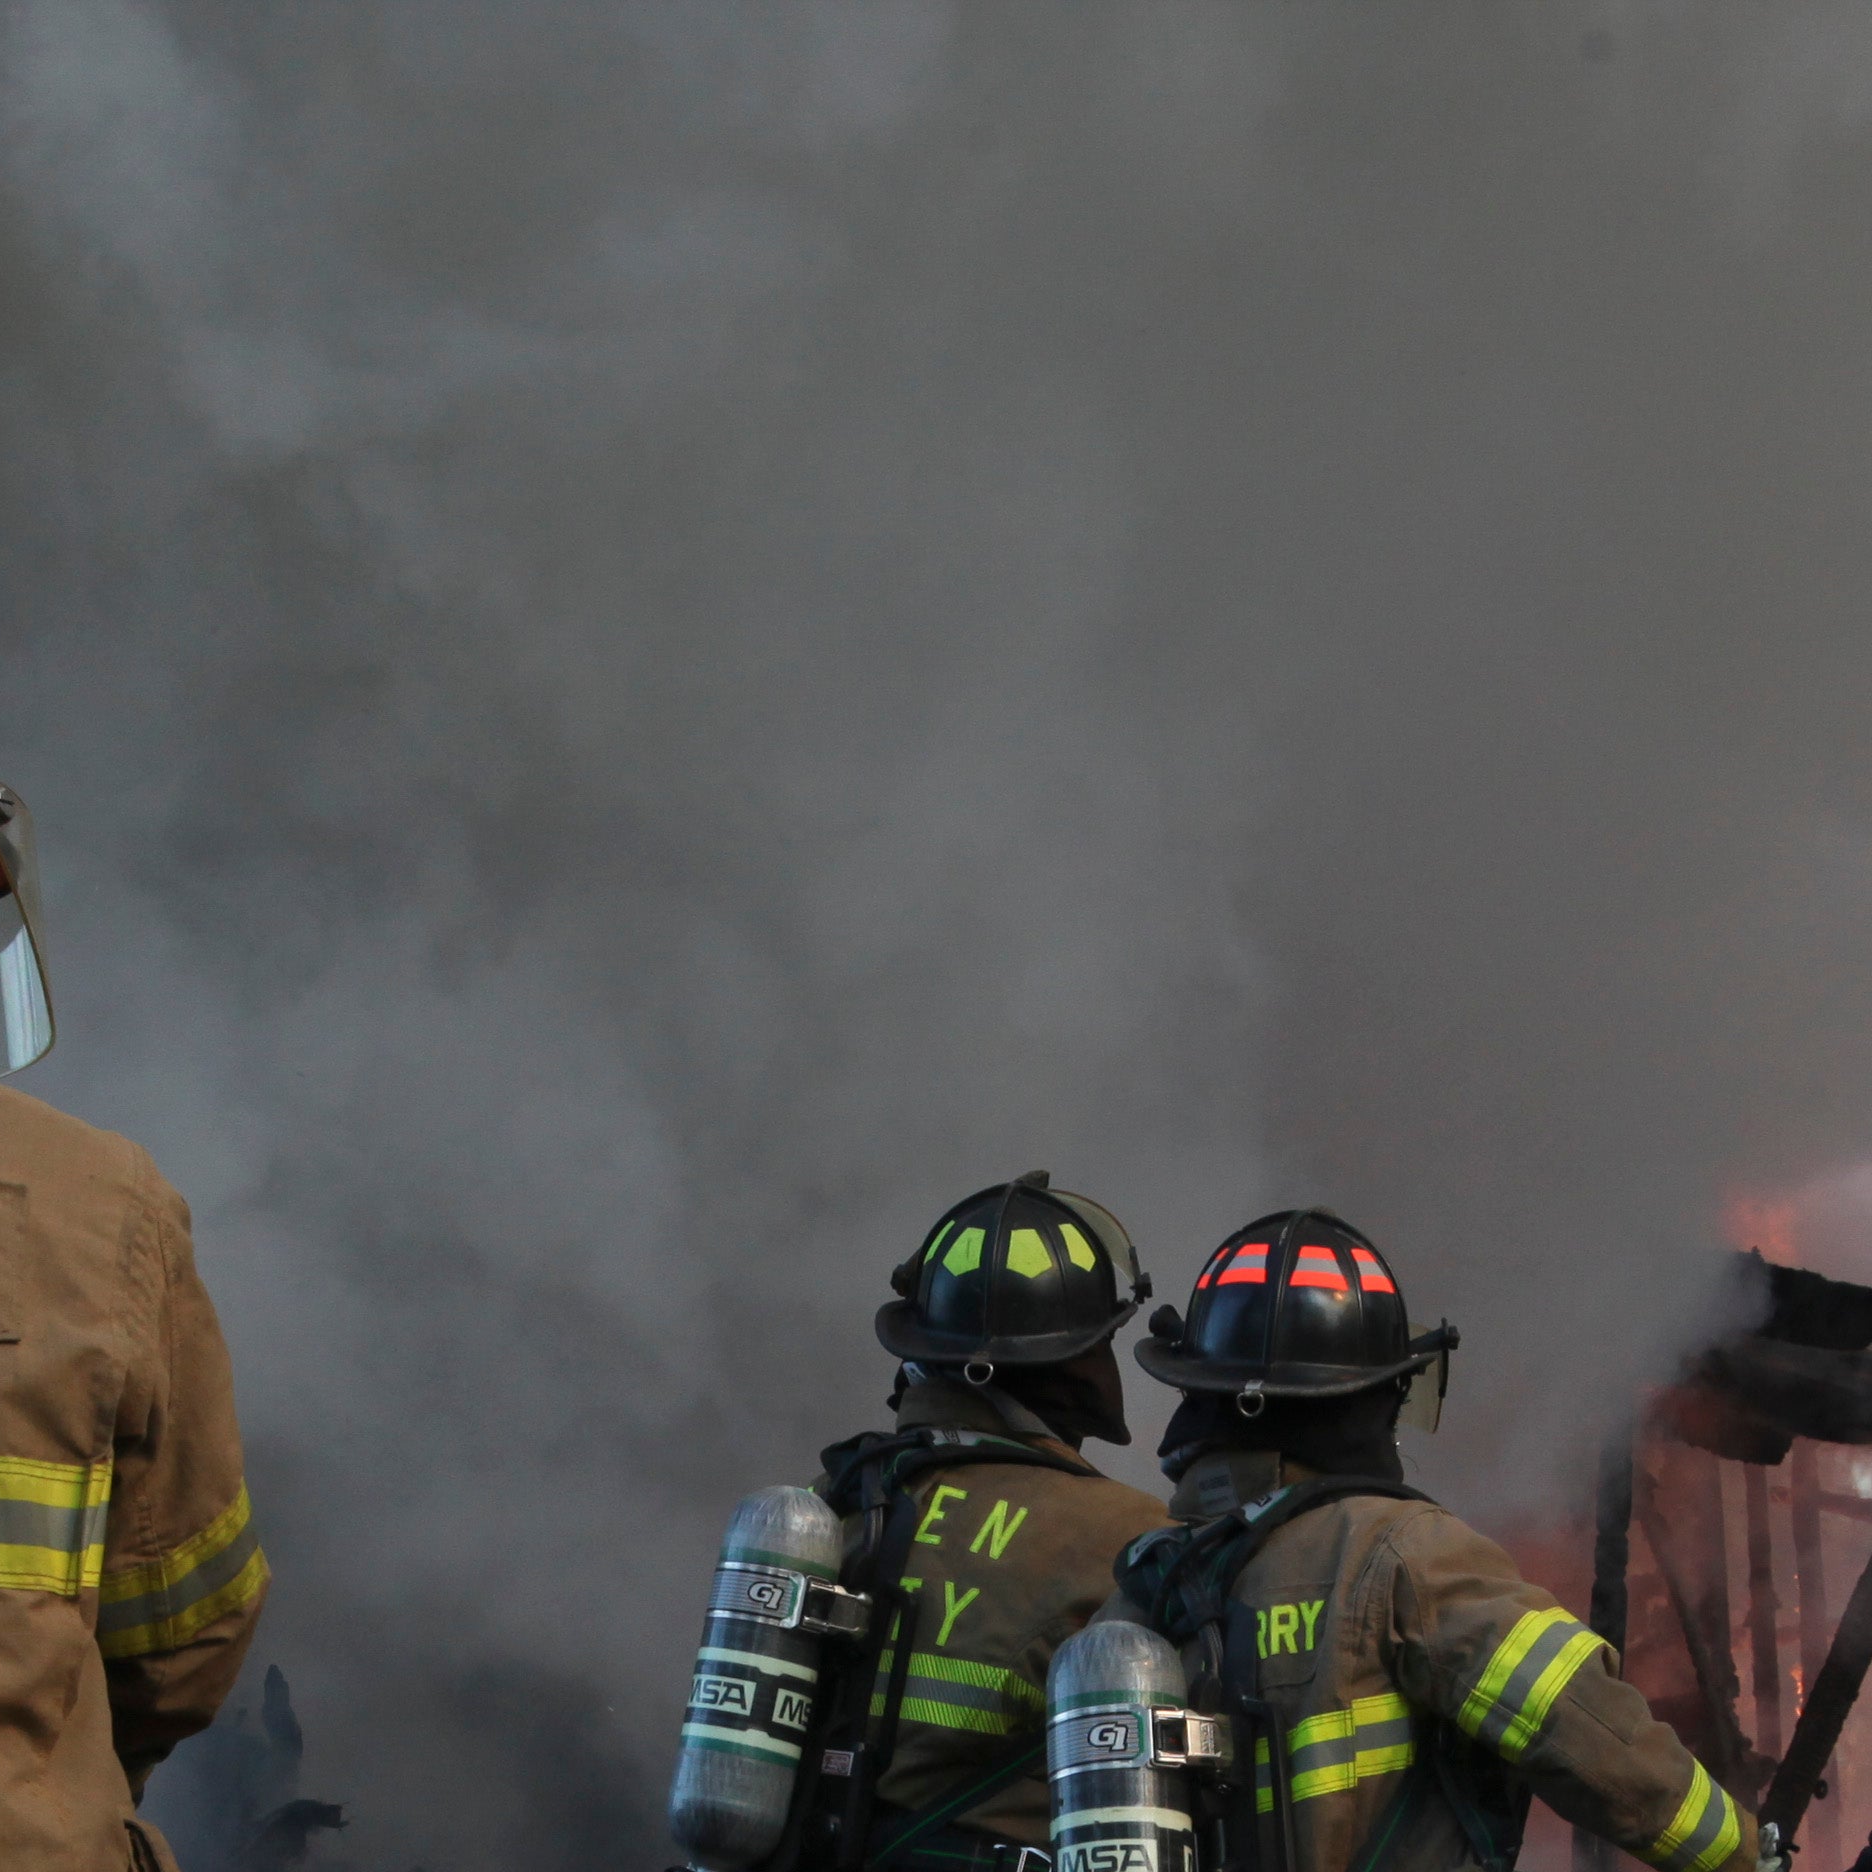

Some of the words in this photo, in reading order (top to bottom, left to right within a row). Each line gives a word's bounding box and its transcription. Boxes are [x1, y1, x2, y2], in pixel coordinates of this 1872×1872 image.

[915, 1485, 1028, 1560] EN
[747, 1581, 785, 1612] G1
[689, 1677, 747, 1710] MSA
[1087, 1721, 1130, 1754] G1
